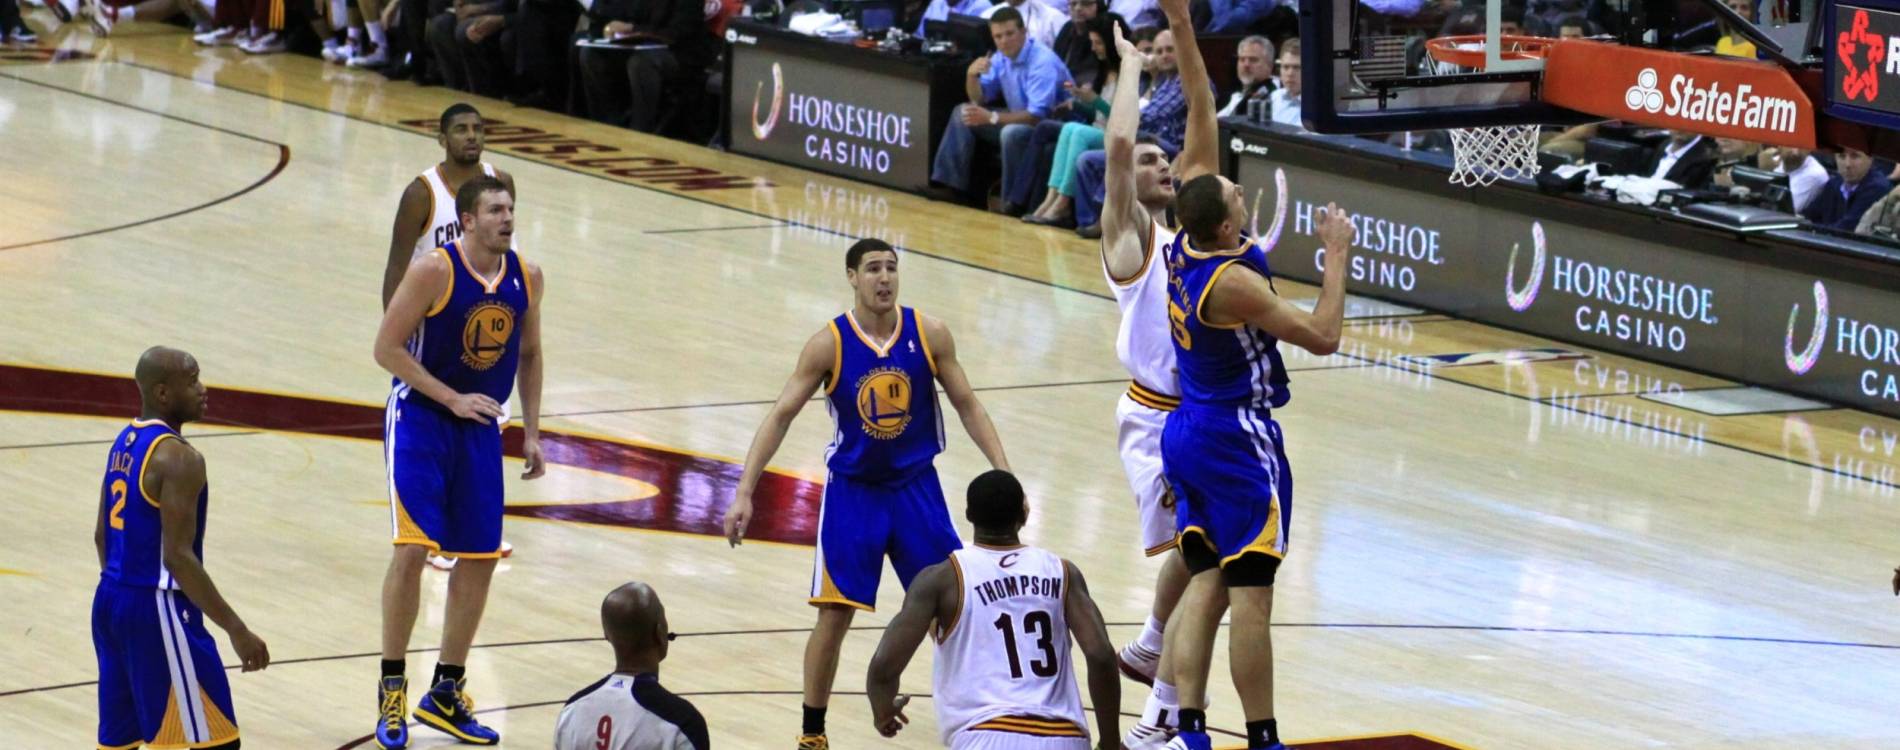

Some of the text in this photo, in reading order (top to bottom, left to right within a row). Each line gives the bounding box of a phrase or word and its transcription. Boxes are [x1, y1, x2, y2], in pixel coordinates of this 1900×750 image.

[789, 92, 911, 148] HORSESHOE
[805, 135, 890, 173] CASINO
[1294, 201, 1441, 265] HSESHOE
[1315, 248, 1416, 291] CSINO
[1553, 256, 1714, 324] HORSESHOE
[492, 318, 505, 333] 10
[1576, 306, 1686, 351] CASINO
[889, 383, 900, 398] 11
[110, 479, 127, 530] 2
[974, 575, 1061, 607] THOMPSON
[993, 610, 1058, 679] 13
[596, 714, 612, 750] 9
